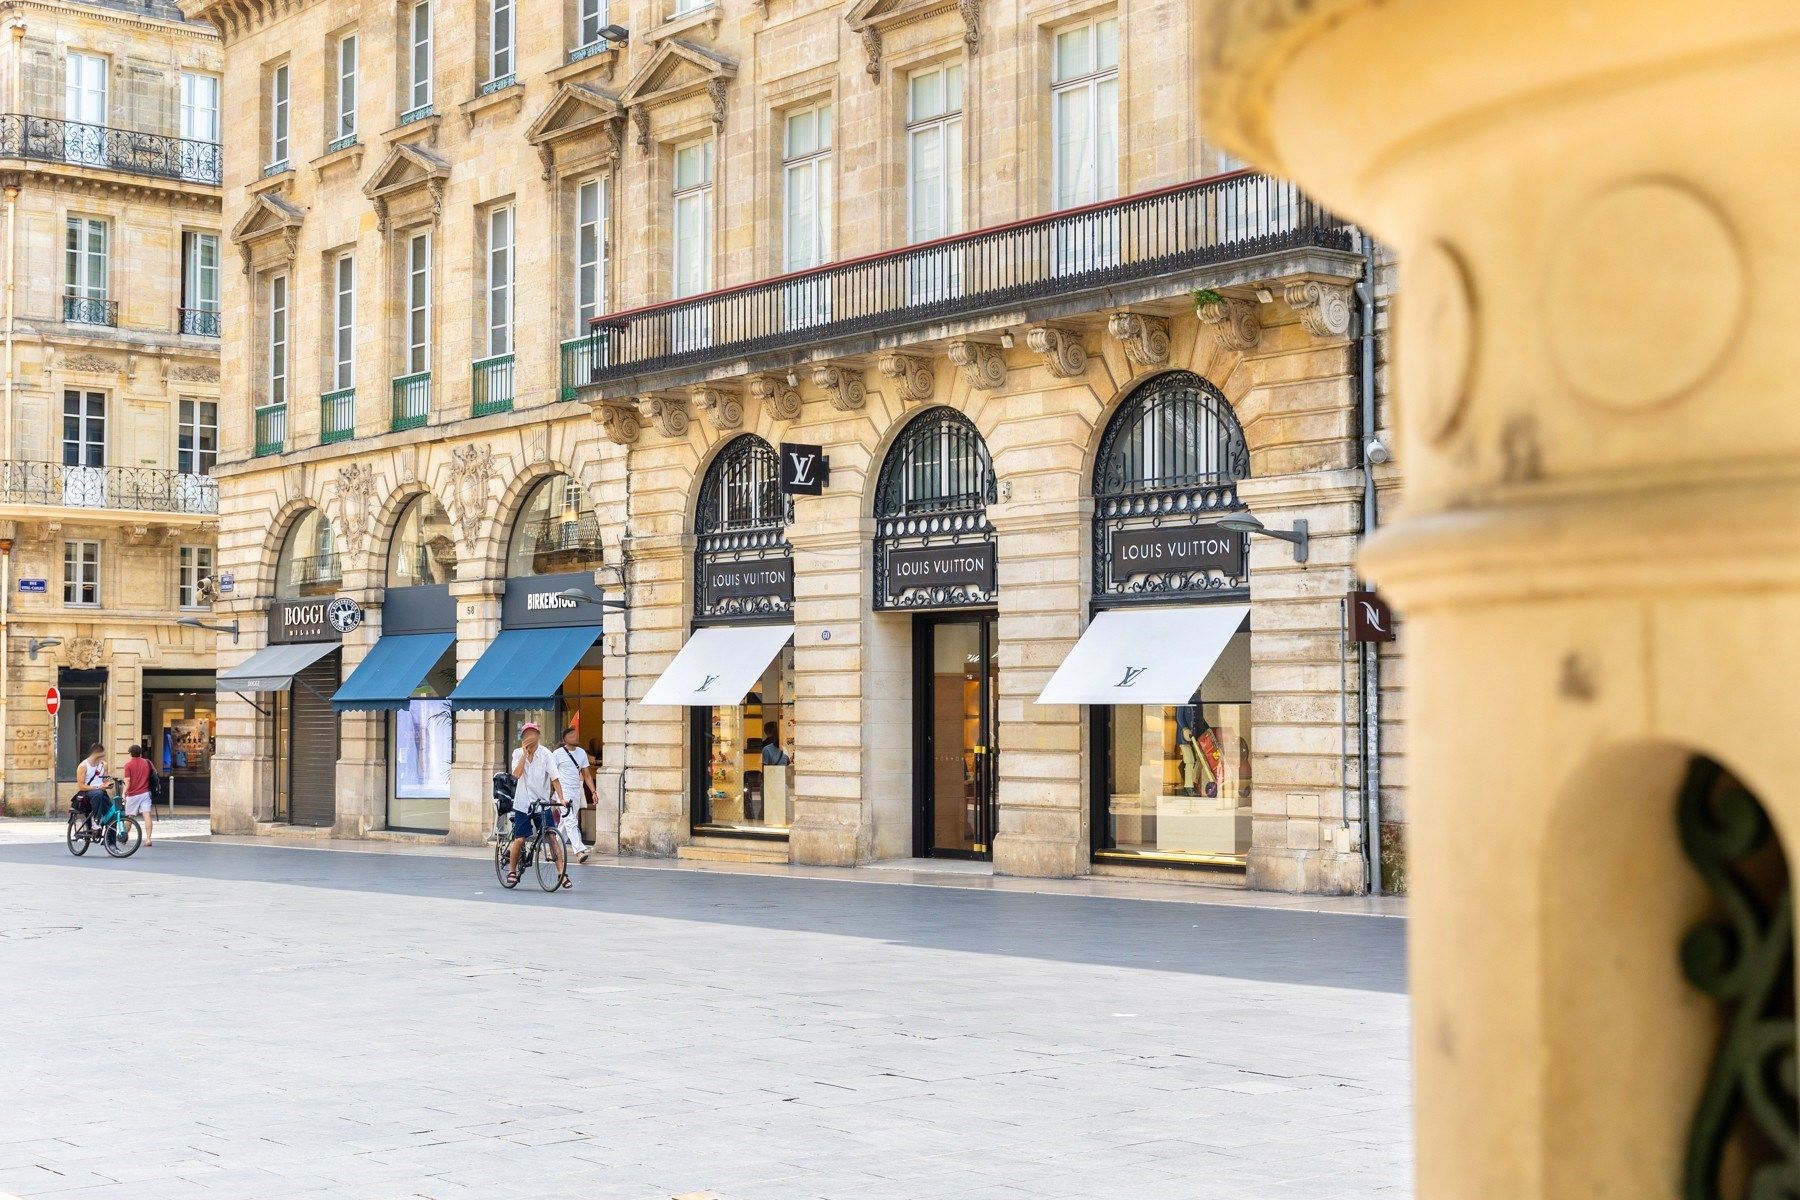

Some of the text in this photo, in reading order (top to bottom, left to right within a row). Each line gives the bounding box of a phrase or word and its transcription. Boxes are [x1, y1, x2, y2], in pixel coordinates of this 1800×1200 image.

[1122, 539, 1230, 560] LOUIS VUITTON
[897, 557, 984, 576] LOUIS VUITTON
[712, 570, 786, 587] LOUIS VUITTON
[284, 604, 325, 626] BOGGI
[466, 605, 475, 615] 58
[289, 628, 321, 636] MILANO
